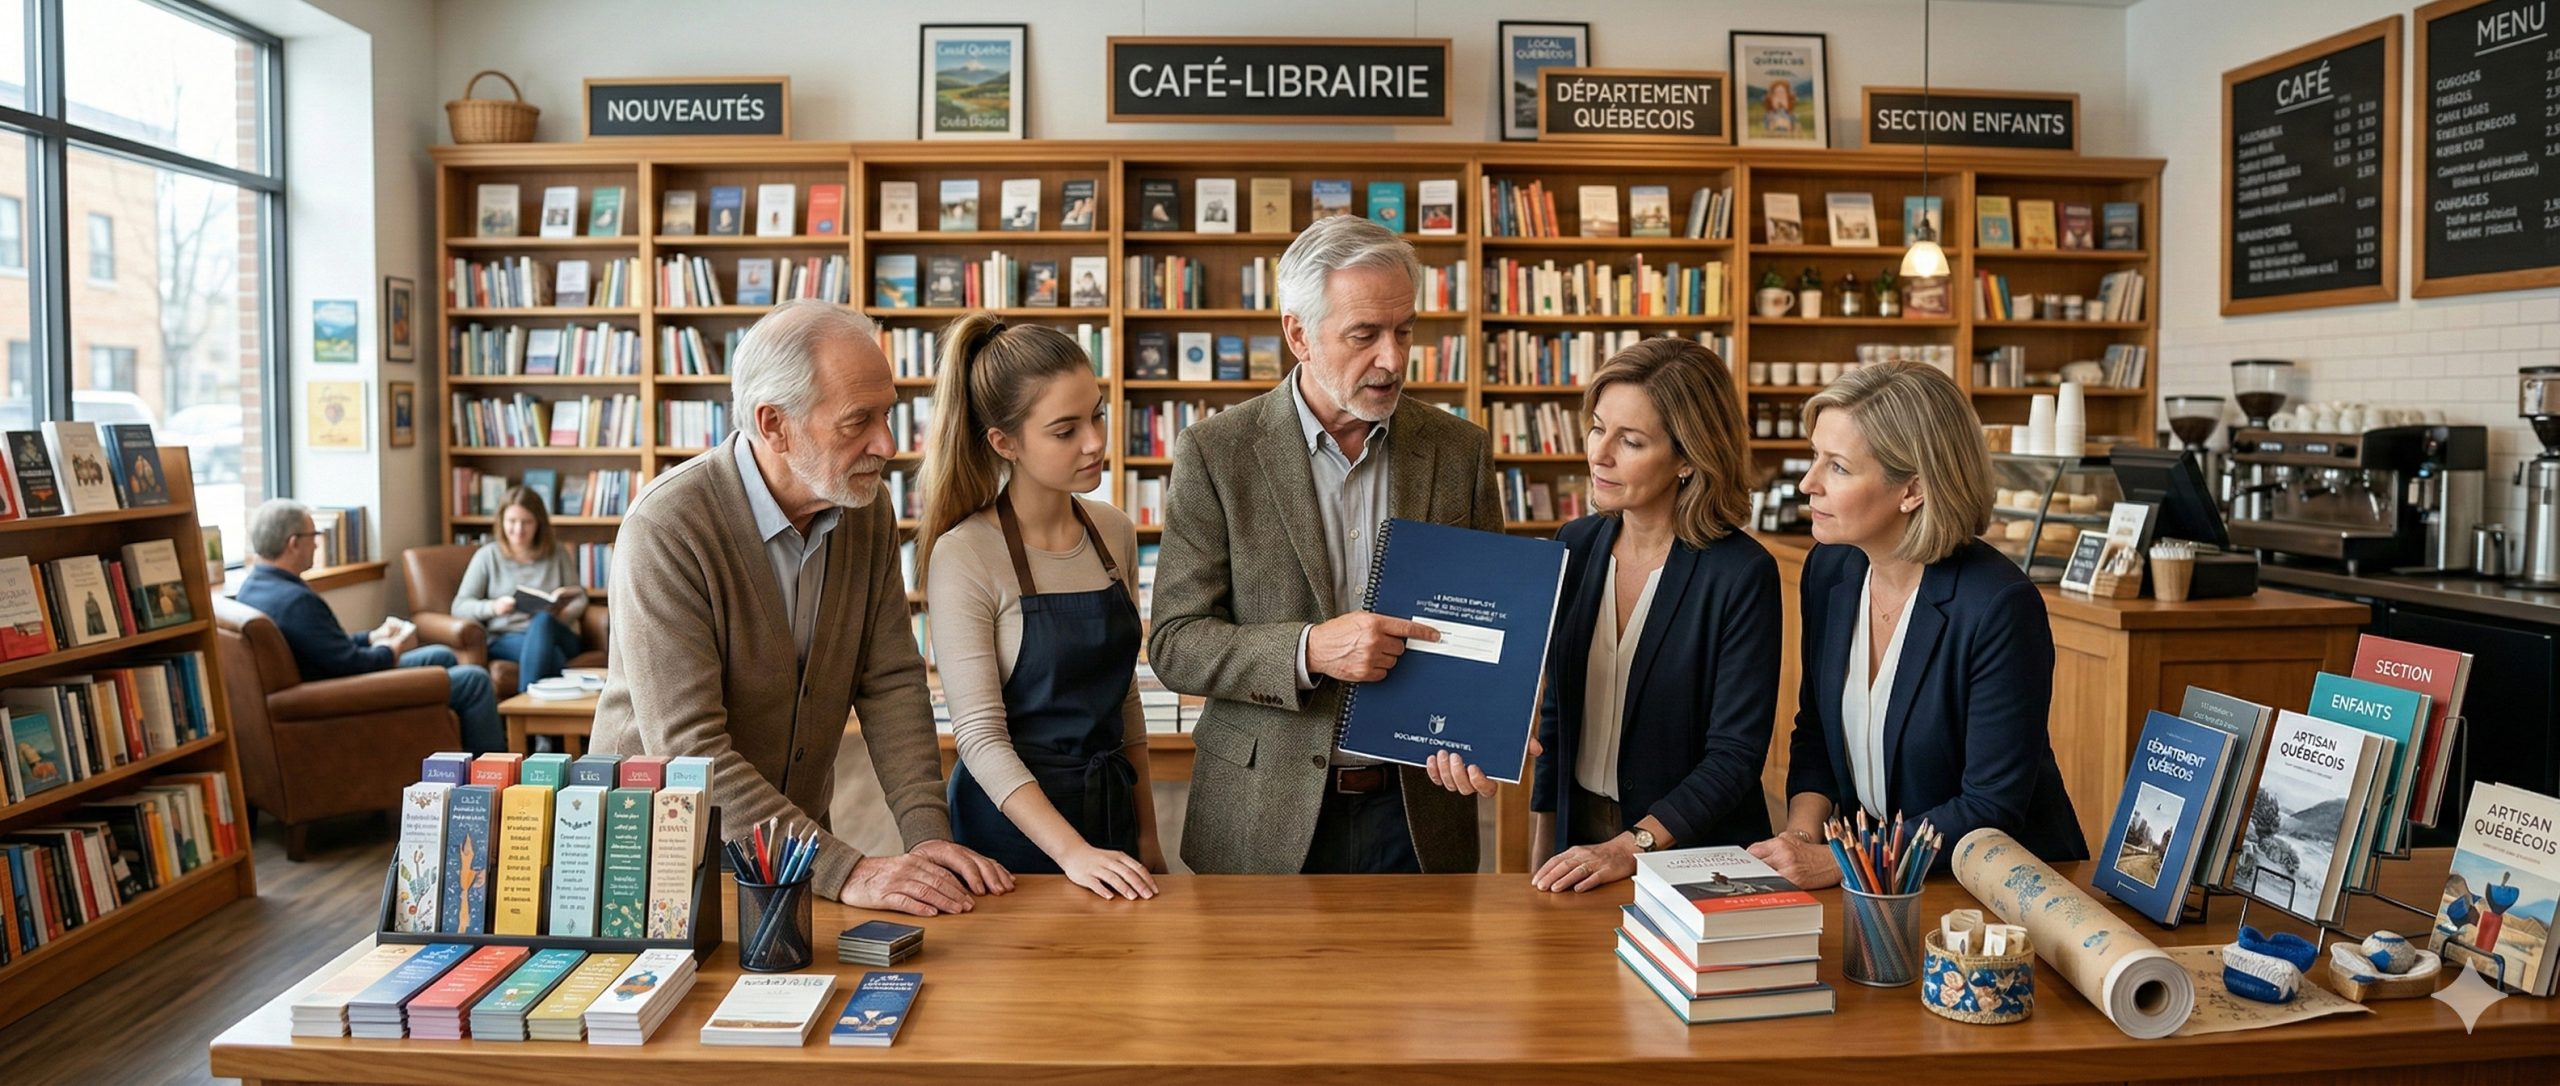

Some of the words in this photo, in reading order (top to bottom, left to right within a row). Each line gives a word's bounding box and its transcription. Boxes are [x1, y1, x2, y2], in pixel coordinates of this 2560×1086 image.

[2477, 1, 2546, 46] MENU
[1527, 39, 1562, 49] LOCAL
[1128, 55, 1430, 98] CAFÉ-LIBRAIRIE
[2276, 60, 2331, 106] CAFÉ
[1557, 78, 1711, 105] DÉPARTEMENT
[608, 93, 765, 122] NOUVEAUTÉS
[1574, 104, 1695, 129] QUÉBECOIS
[1877, 109, 1967, 132] SECTION
[1973, 112, 2065, 135] ENFANTS
[2375, 659, 2433, 683] SECTION
[2331, 694, 2393, 720] ENFANTS
[2292, 730, 2337, 751] ARTISAN
[2280, 742, 2345, 770] QUÉBECOIS
[2487, 803, 2552, 833] ARTISAN
[2474, 818, 2558, 855] QUÉBÉCOIS
